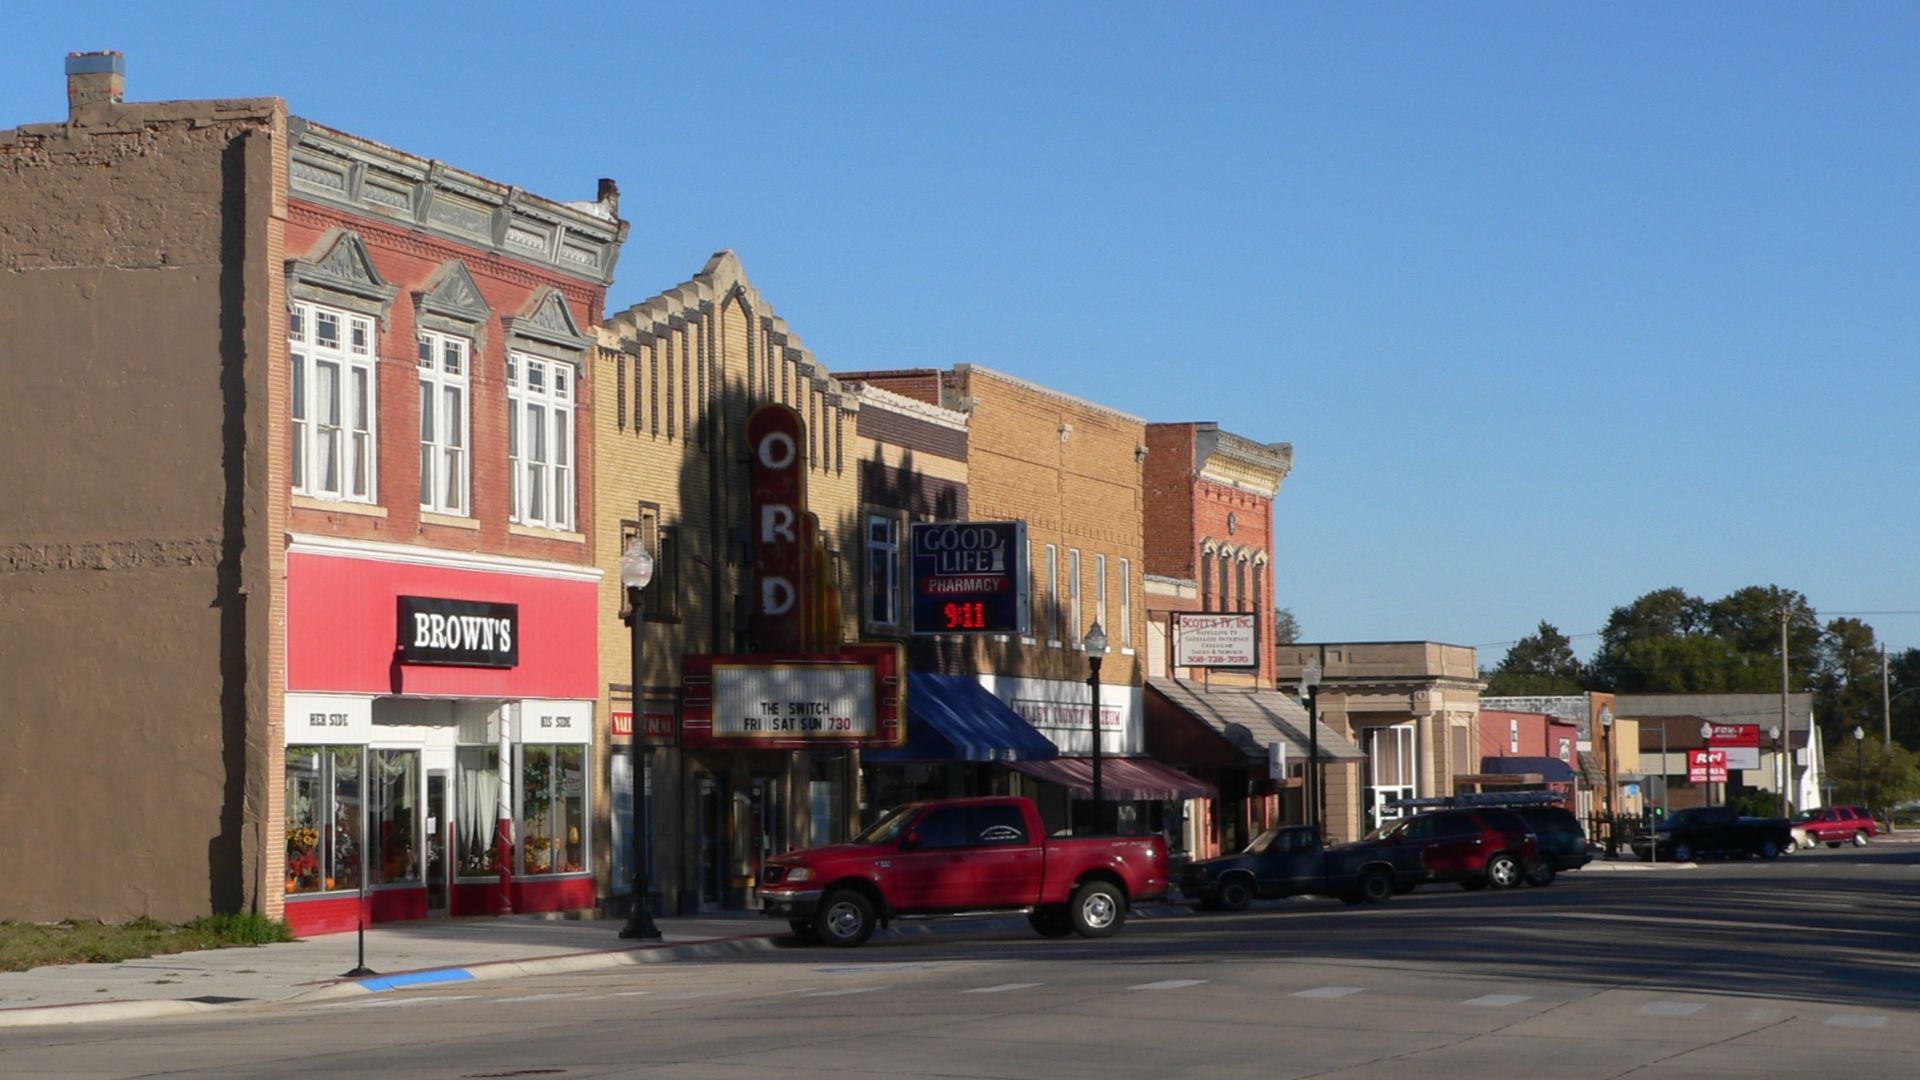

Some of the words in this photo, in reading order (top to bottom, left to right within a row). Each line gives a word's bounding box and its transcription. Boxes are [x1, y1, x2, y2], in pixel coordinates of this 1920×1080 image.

[924, 528, 998, 550] GOOD
[942, 551, 989, 572] LIFE
[928, 578, 1001, 592] PHARMACY
[944, 603, 985, 628] 9:11
[414, 612, 511, 652] BROWN'S
[761, 702, 779, 715] THE
[789, 702, 830, 715] SWITCH
[310, 713, 326, 726] HER
[329, 713, 349, 727] SIDE
[541, 716, 553, 728] HIS
[556, 716, 571, 728] SIDE
[744, 718, 761, 730] FRI
[772, 718, 796, 730] SAT
[801, 718, 822, 730] SUN
[828, 718, 851, 730] 730
